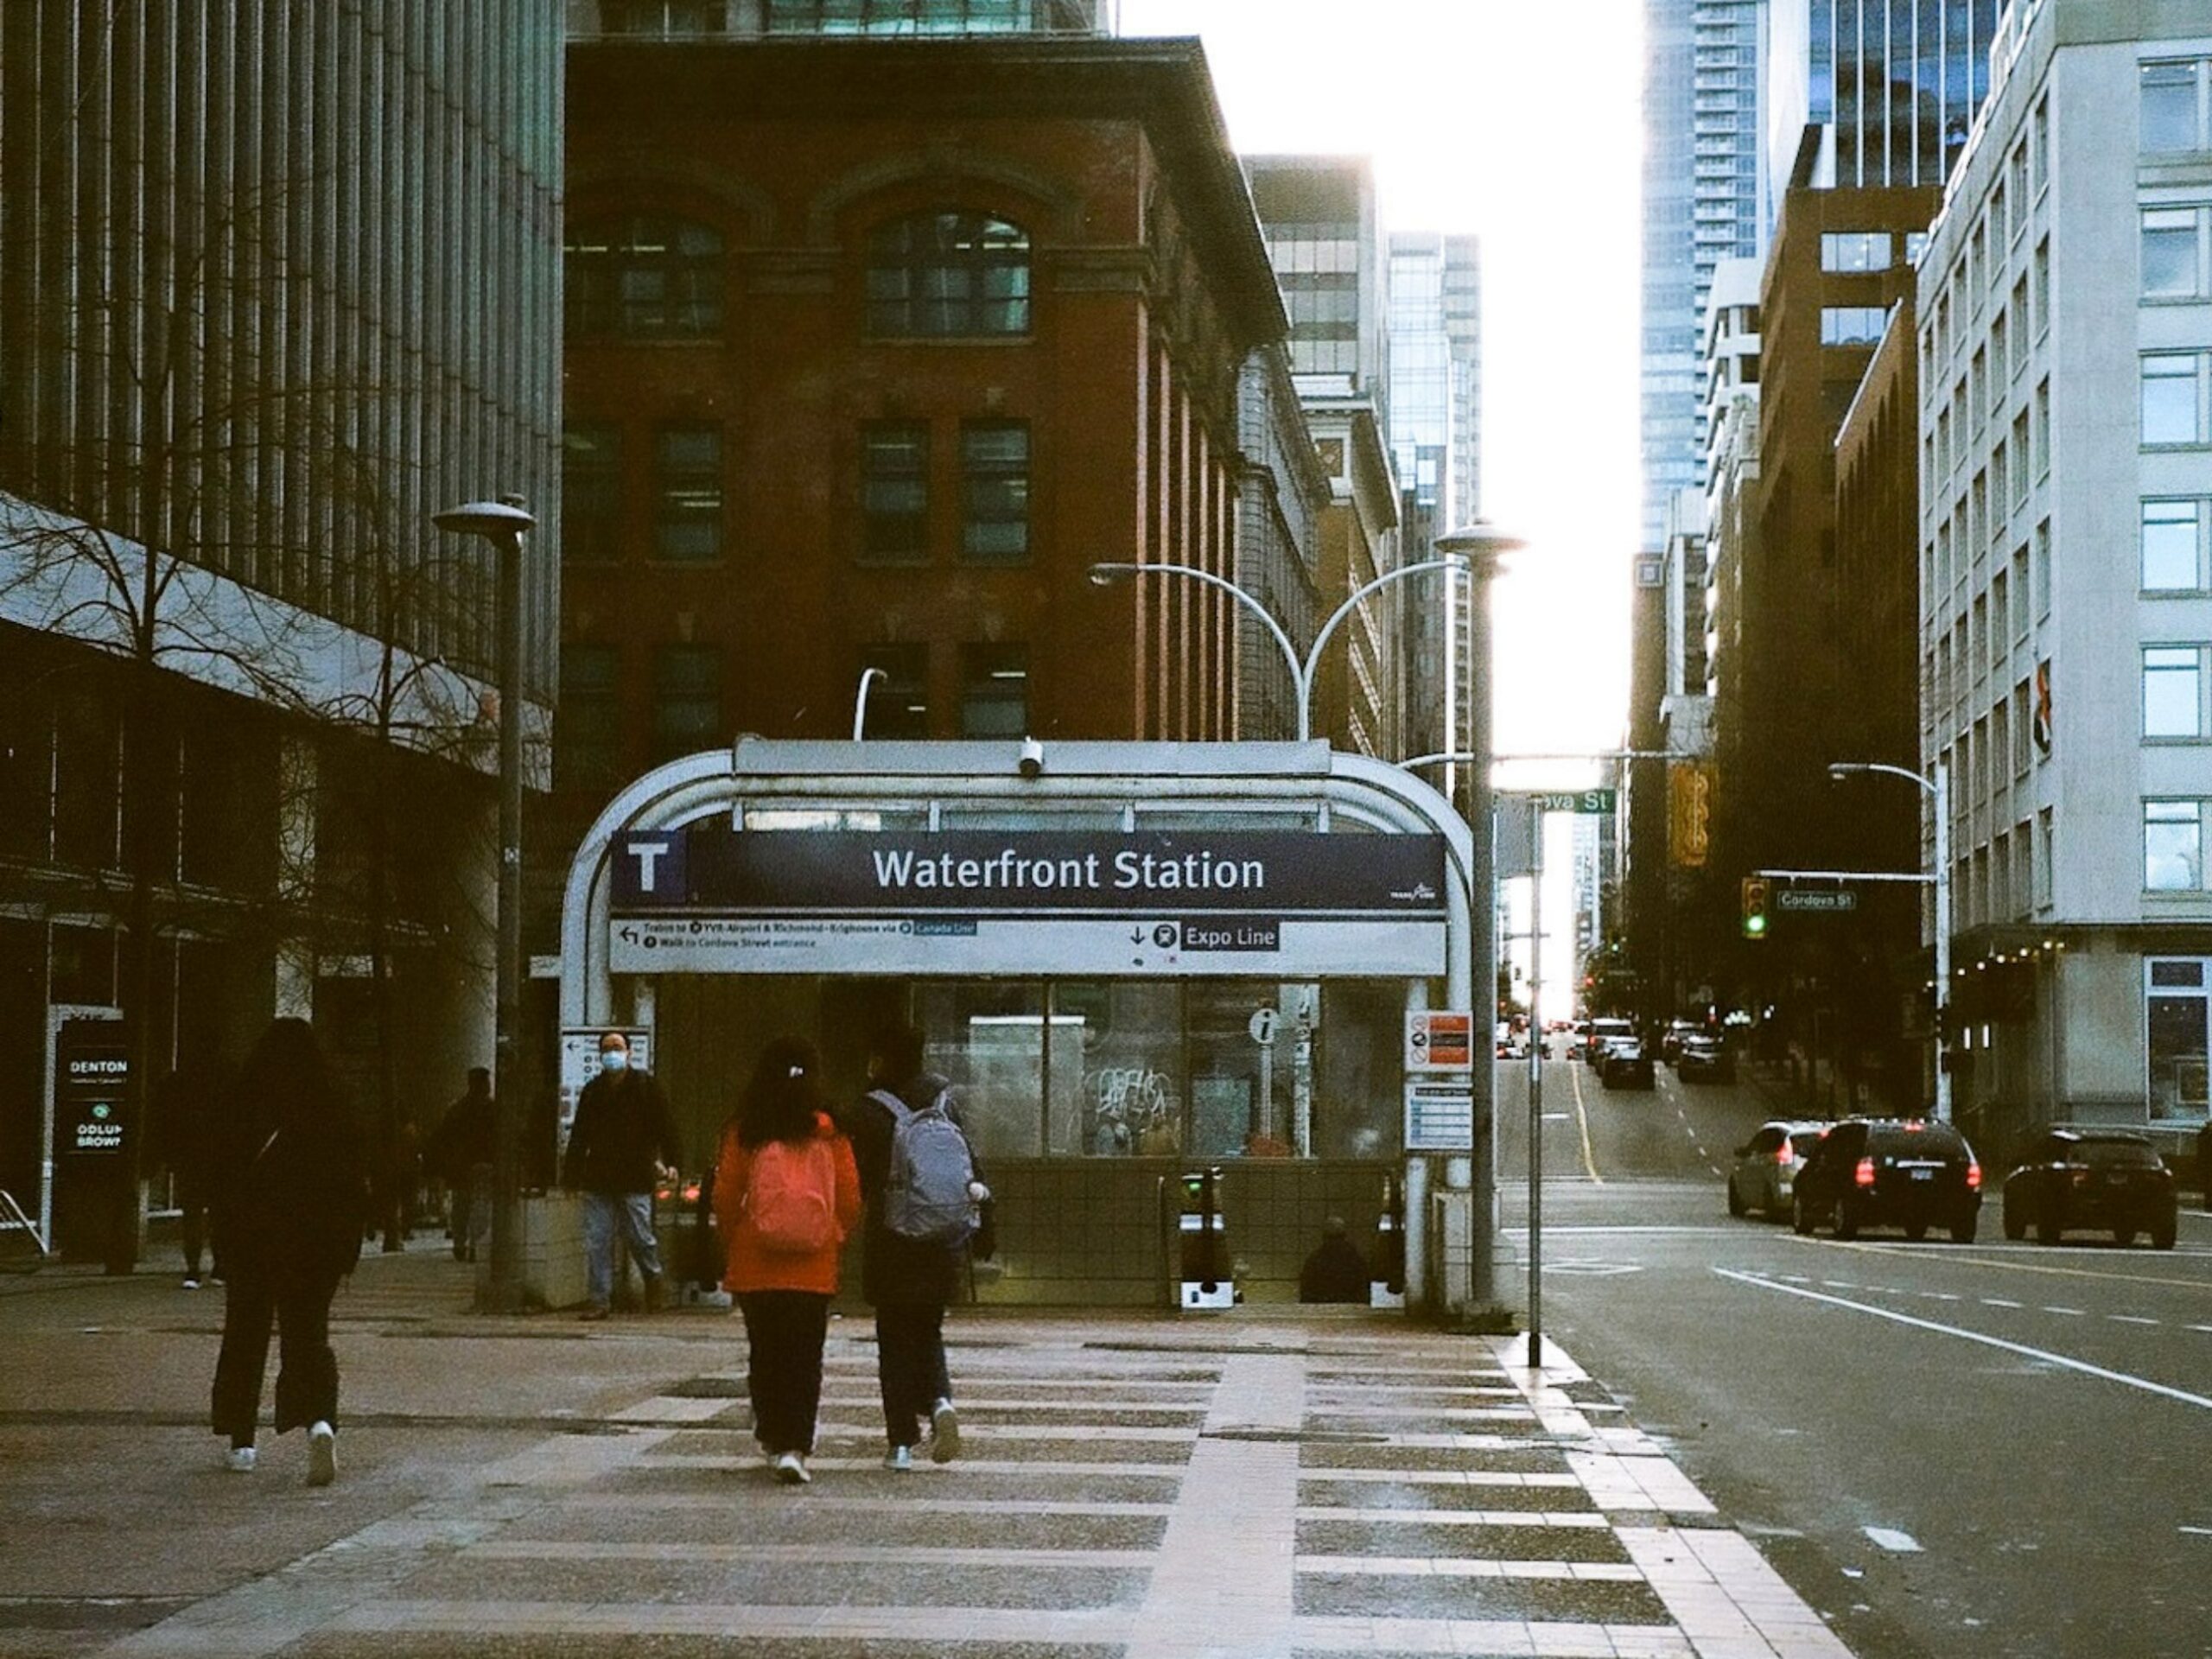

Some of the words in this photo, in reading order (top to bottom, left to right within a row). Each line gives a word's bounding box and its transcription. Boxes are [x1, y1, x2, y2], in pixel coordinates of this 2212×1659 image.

[1584, 791, 1607, 810] St
[628, 842, 670, 892] T
[873, 849, 1100, 888] Waterfront
[1114, 849, 1265, 889] Station
[1783, 893, 1834, 906] Cordova
[1838, 893, 1852, 906] St
[1186, 928, 1232, 950] Expo
[1238, 927, 1275, 945] Line
